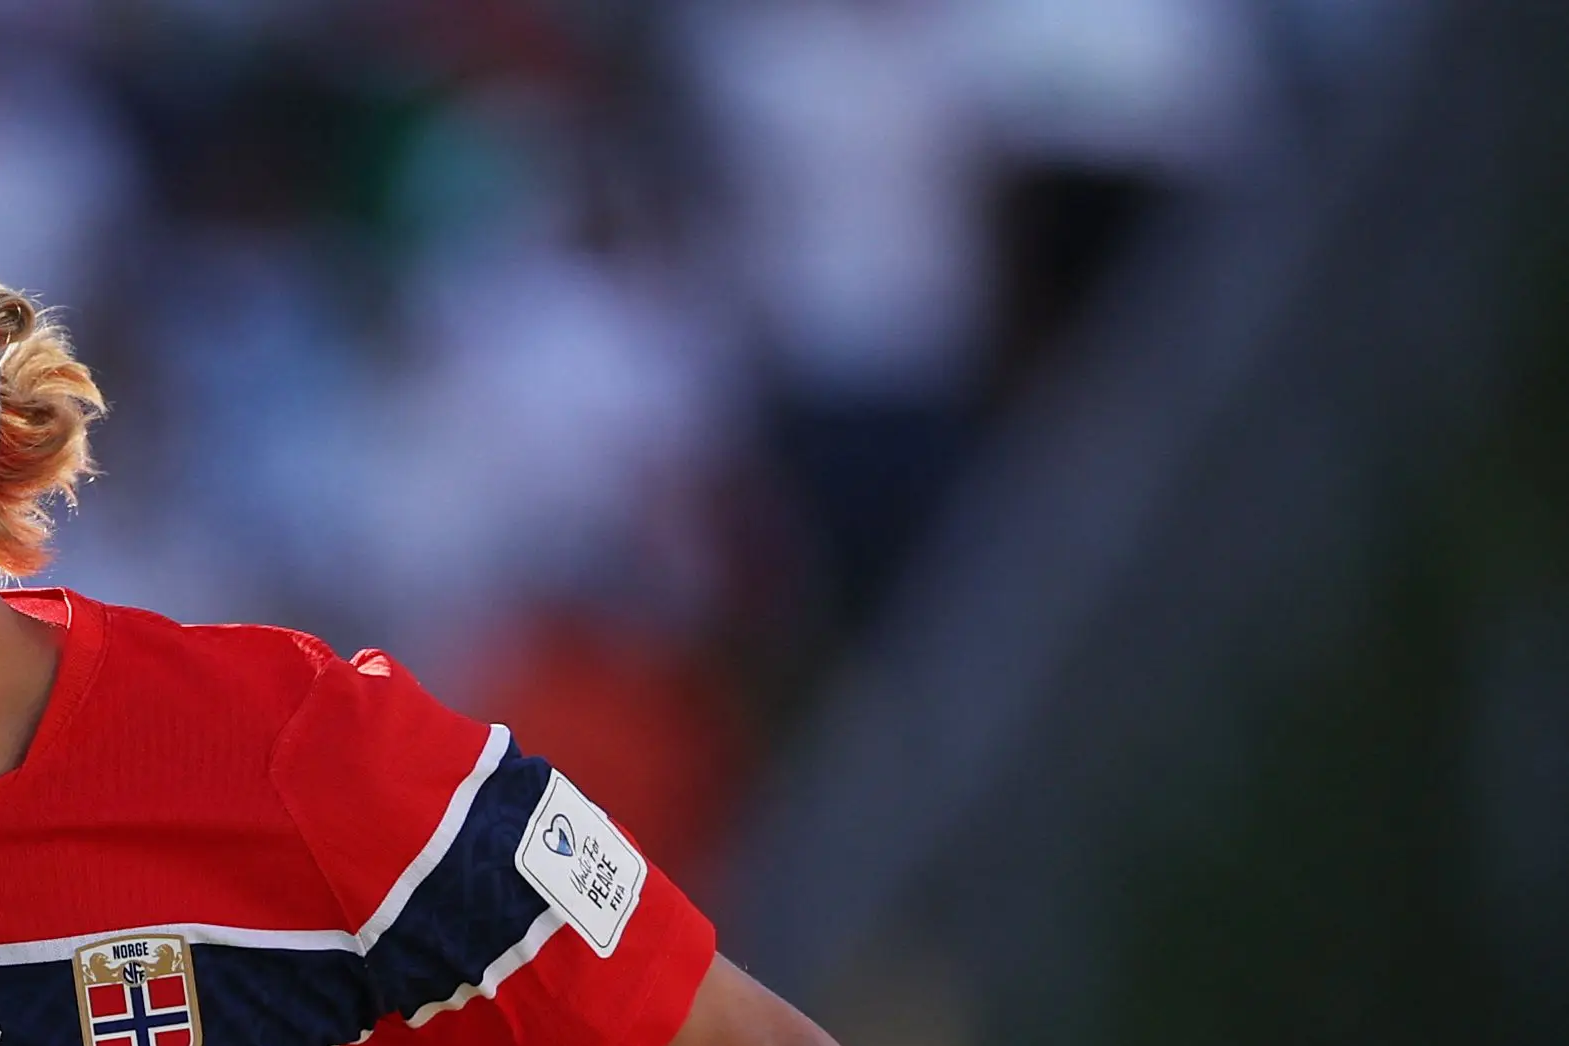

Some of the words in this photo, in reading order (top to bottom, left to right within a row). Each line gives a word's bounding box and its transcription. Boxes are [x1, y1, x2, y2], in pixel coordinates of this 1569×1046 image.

[583, 836, 600, 863] For
[588, 854, 617, 909] PEACE
[610, 885, 625, 911] FIFA
[112, 941, 149, 960] NORGE
